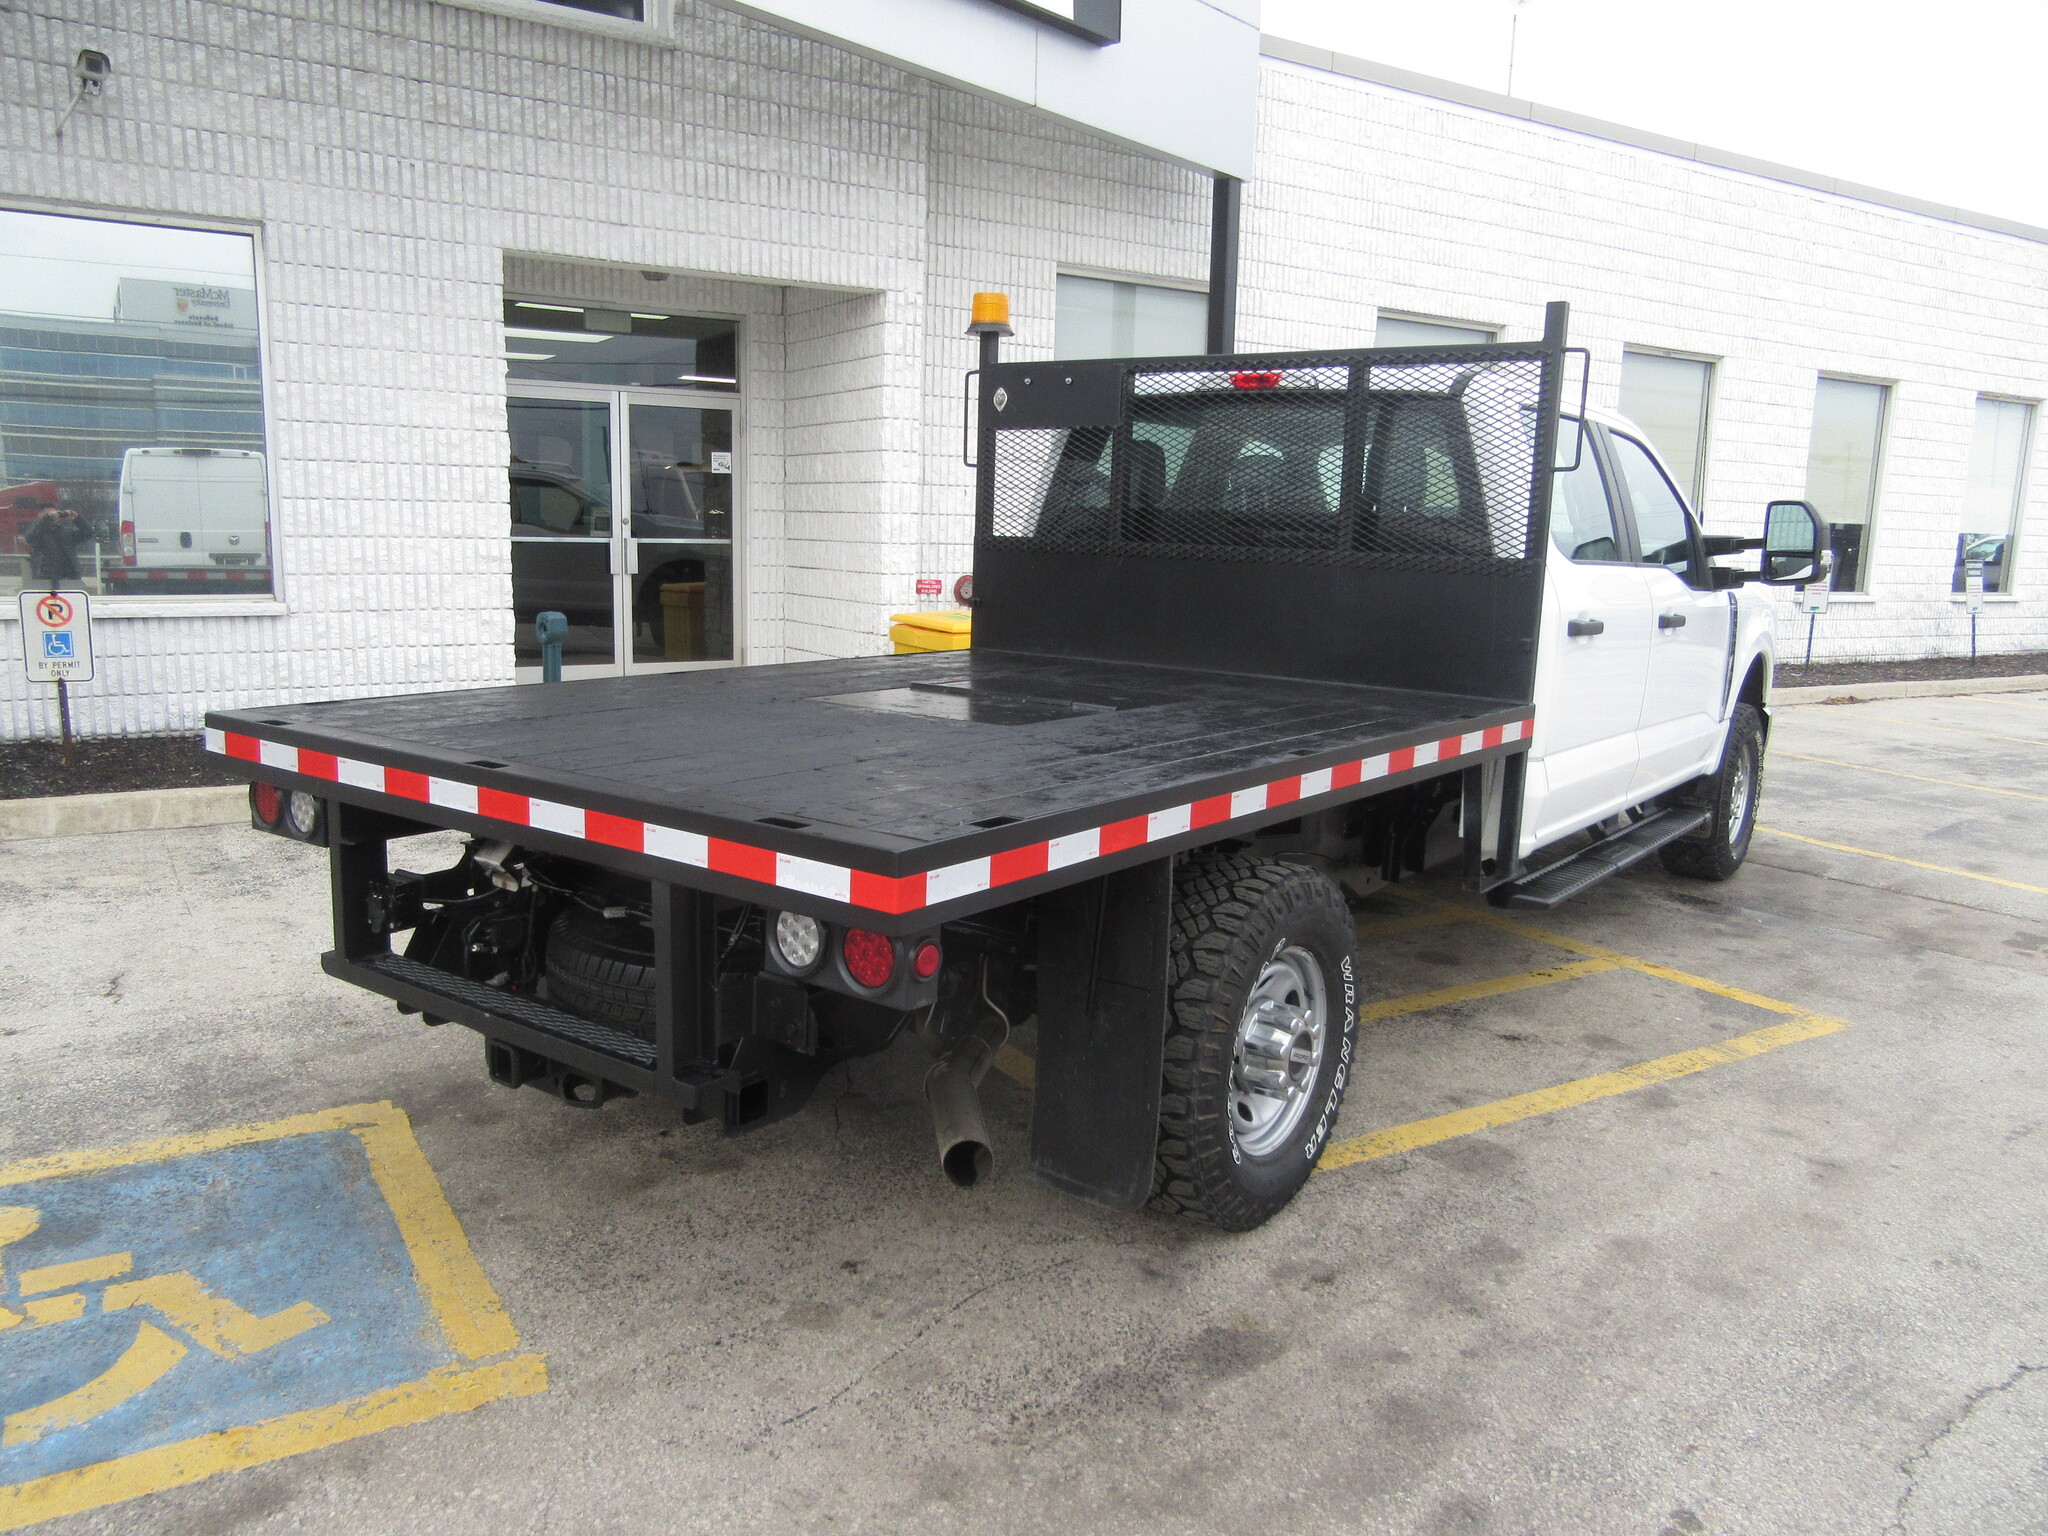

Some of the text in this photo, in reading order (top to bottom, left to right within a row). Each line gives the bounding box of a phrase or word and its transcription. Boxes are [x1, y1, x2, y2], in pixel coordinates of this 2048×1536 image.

[39, 661, 80, 669] BY PERMIT
[51, 669, 70, 677] ONLY
[1304, 955, 1354, 1160] WRANGLER
